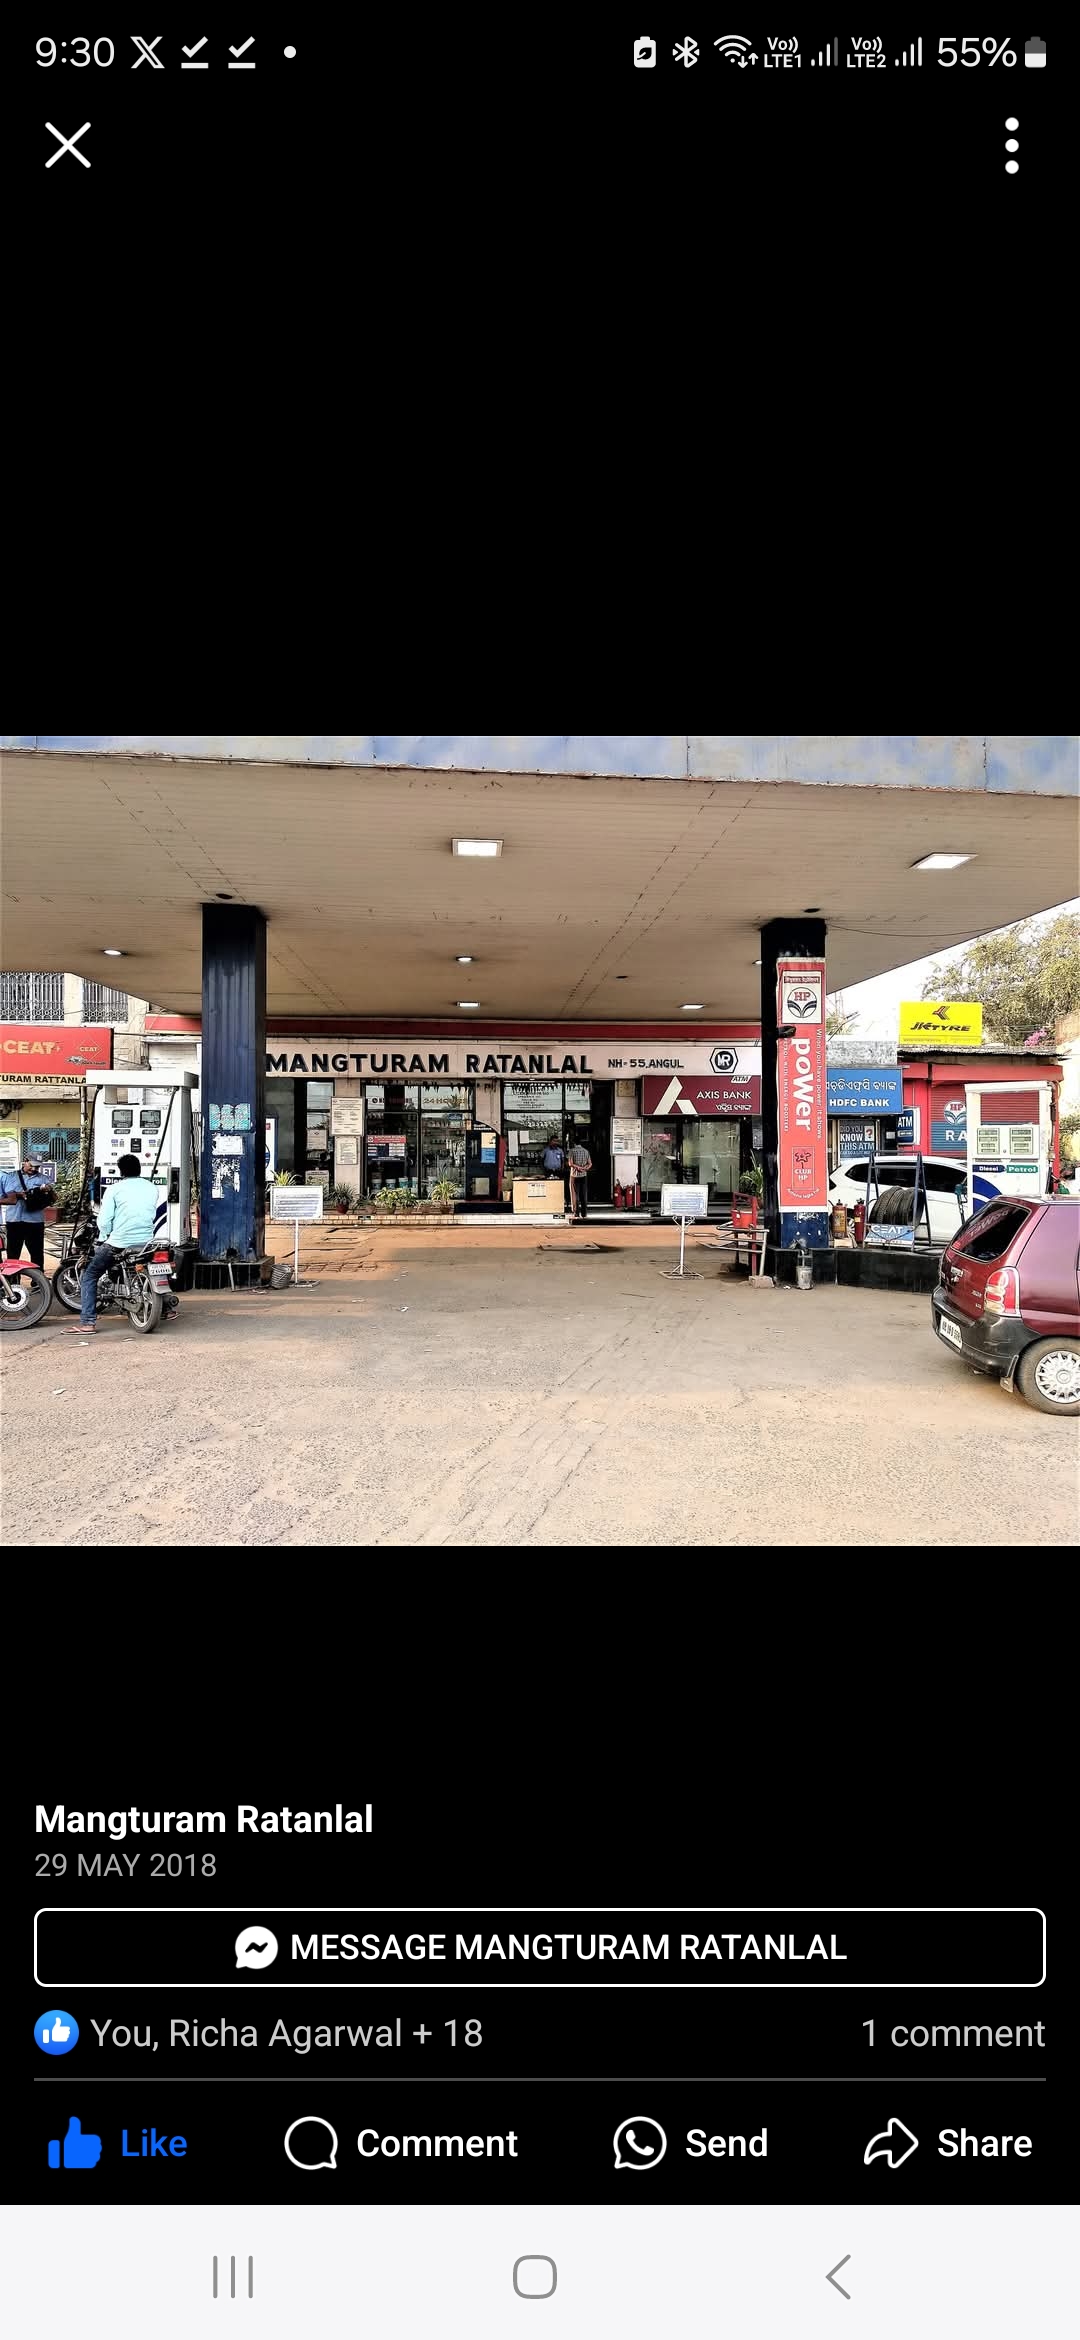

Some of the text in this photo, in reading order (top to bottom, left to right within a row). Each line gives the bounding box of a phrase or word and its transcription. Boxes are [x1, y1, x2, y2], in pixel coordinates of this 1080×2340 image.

[794, 992, 811, 1001] HP
[4, 1040, 56, 1054] CEAT
[266, 1054, 593, 1073] MANGTURAM RATANLAL
[697, 1091, 752, 1099] AXIS BANK
[829, 1099, 890, 1107] HDFC BANK
[898, 1117, 913, 1128] ATM
[840, 1133, 863, 1142] KNOW
[840, 1143, 875, 1151] THIS ATM
[871, 1225, 903, 1235] CEAT
